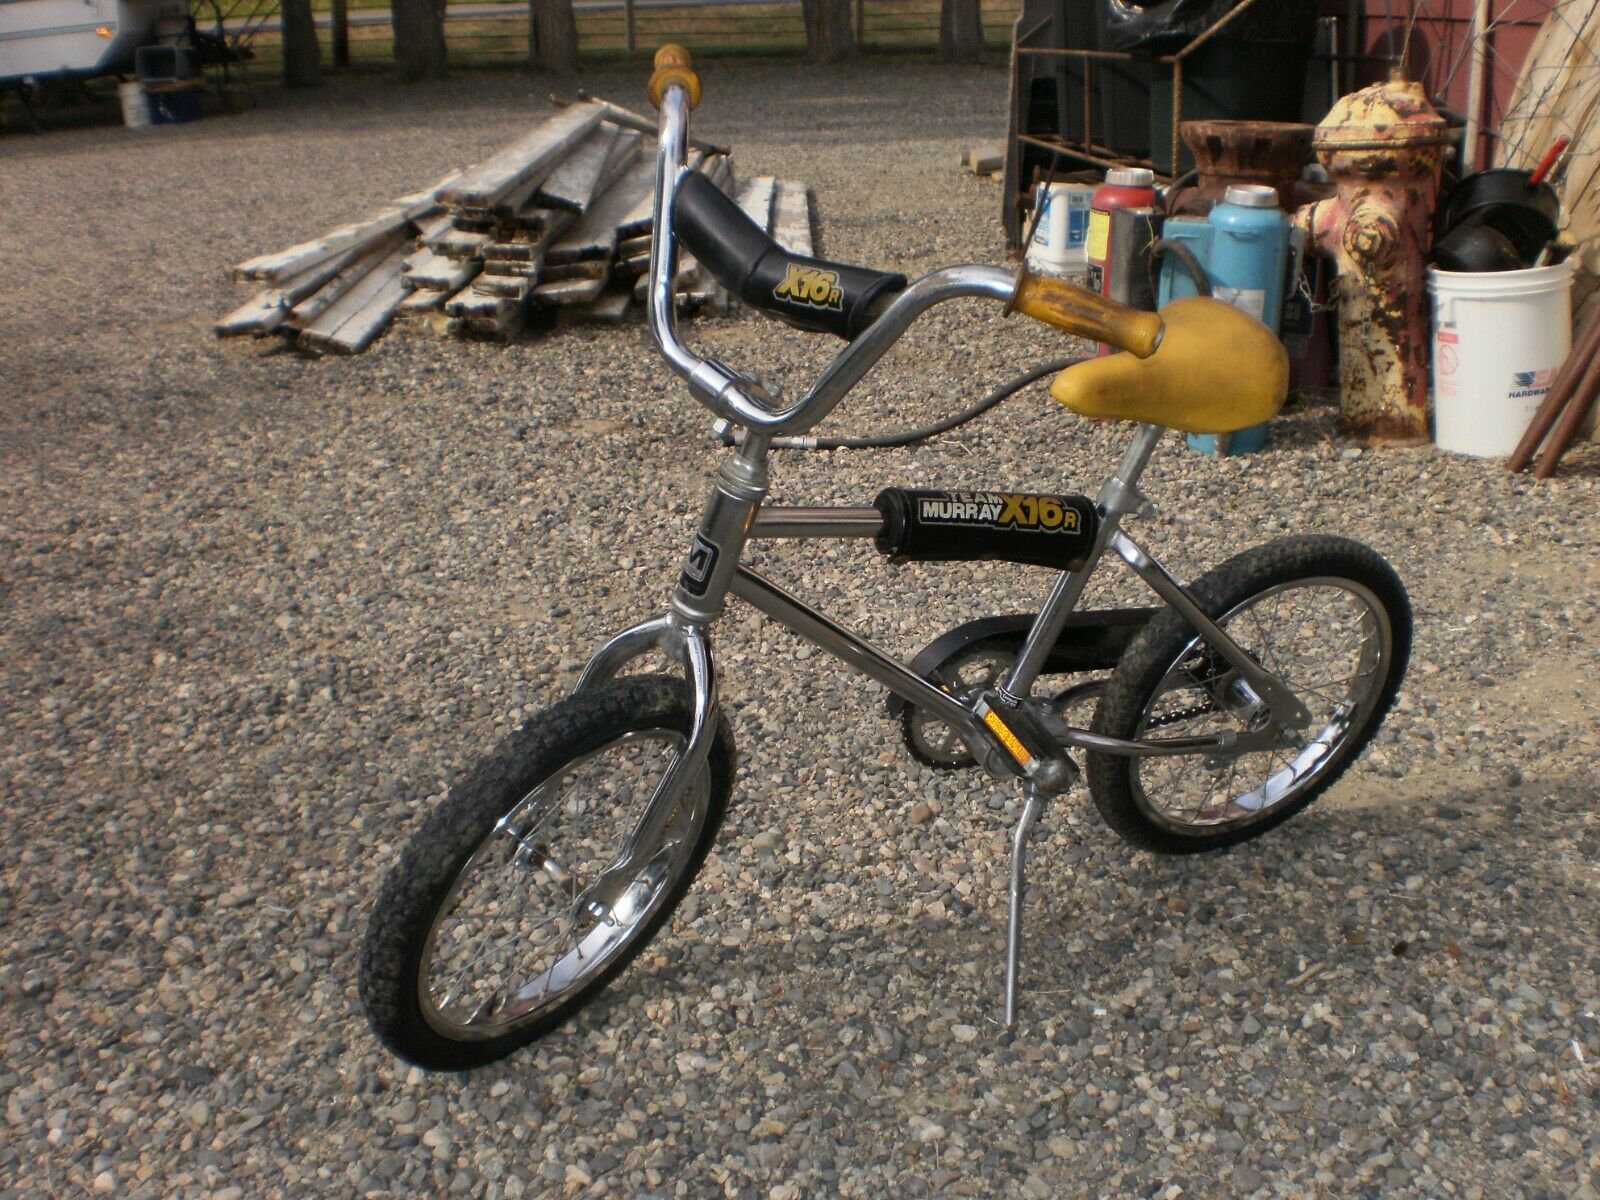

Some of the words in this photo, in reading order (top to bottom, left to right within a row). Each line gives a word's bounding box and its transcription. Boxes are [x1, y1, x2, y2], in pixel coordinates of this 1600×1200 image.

[1508, 387, 1551, 399] HARDWAR
[945, 491, 1004, 504] TEAM
[922, 501, 1003, 521] MURRAY
